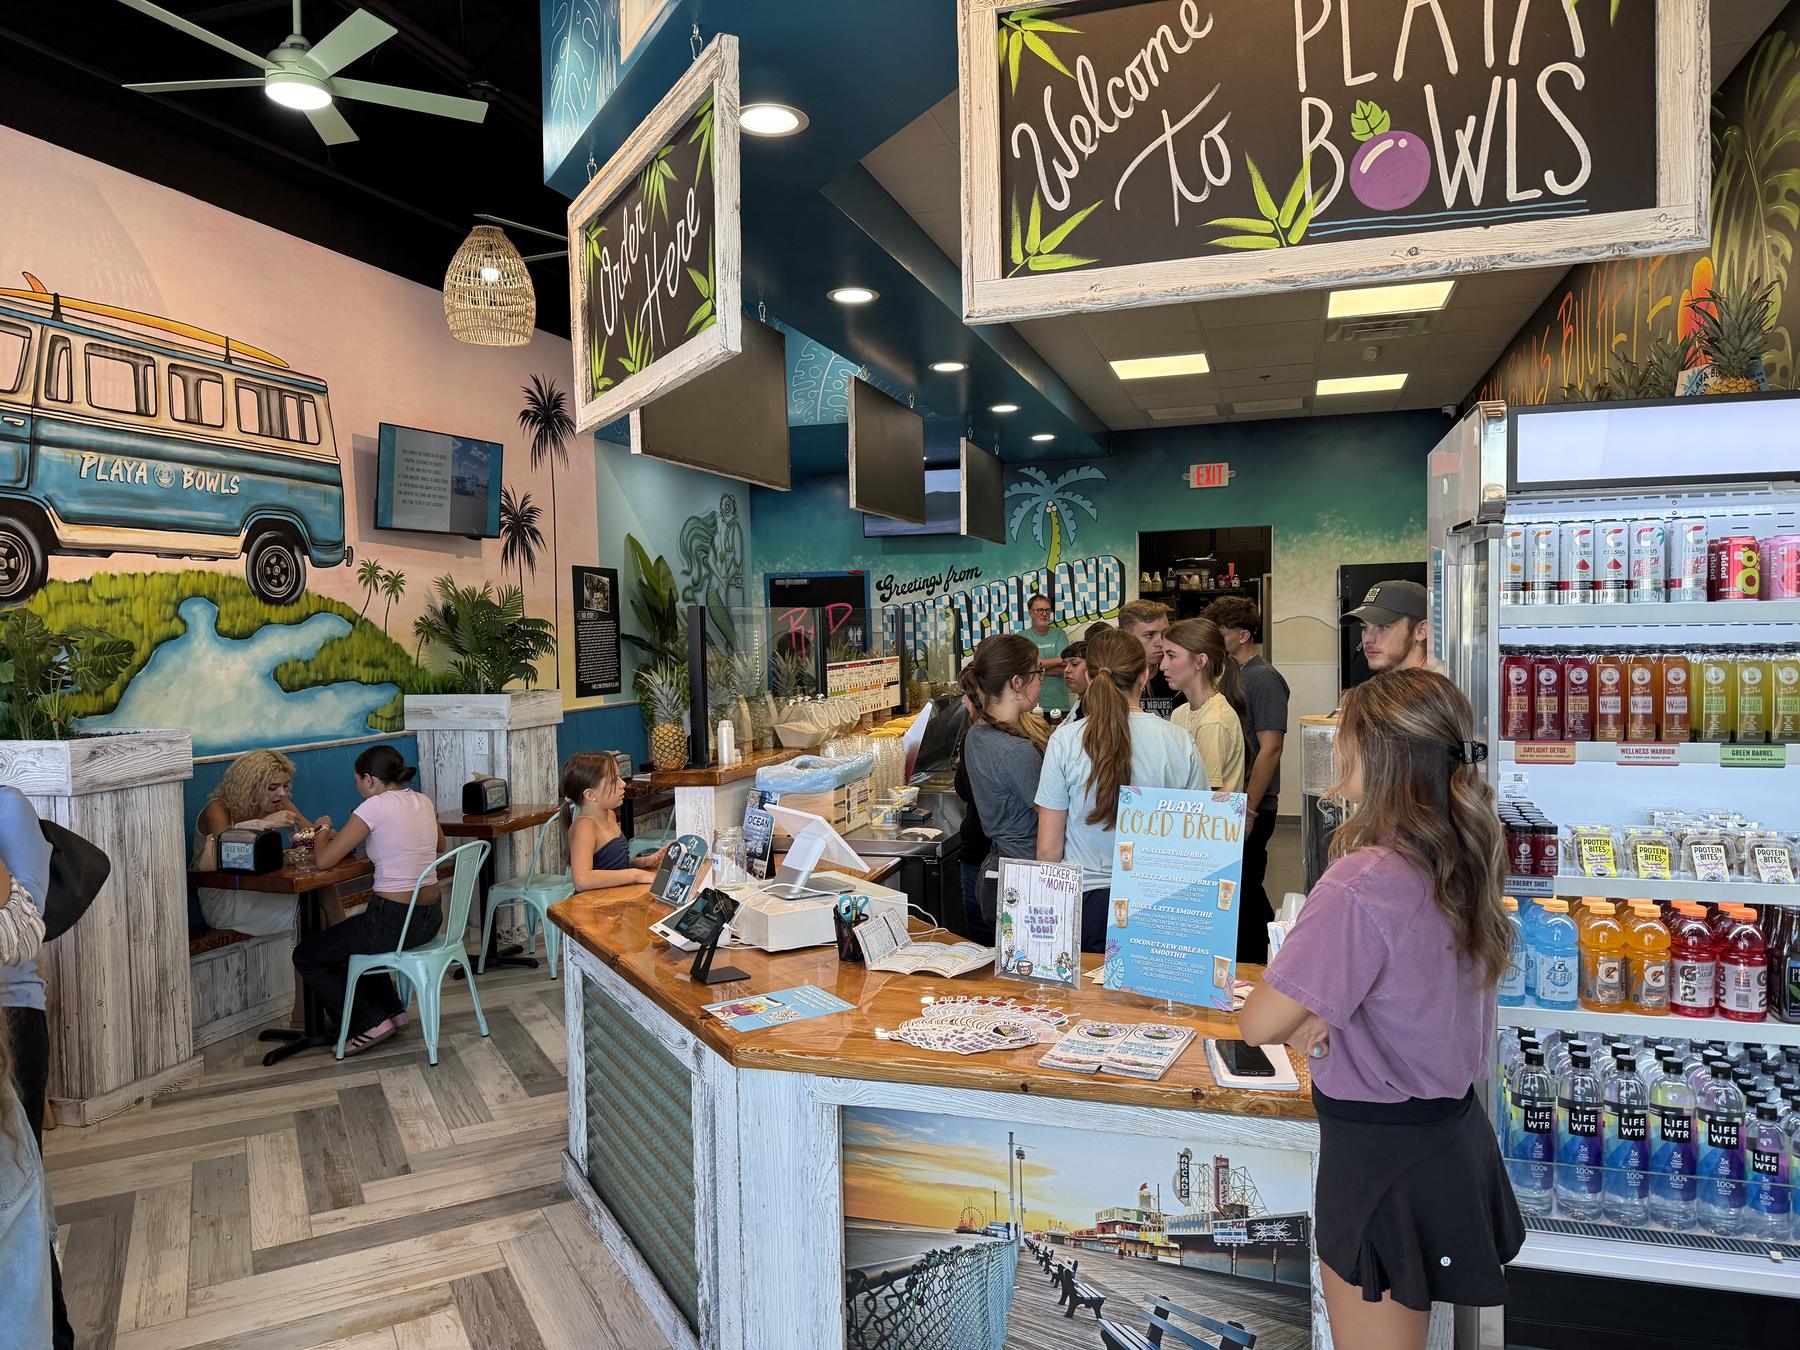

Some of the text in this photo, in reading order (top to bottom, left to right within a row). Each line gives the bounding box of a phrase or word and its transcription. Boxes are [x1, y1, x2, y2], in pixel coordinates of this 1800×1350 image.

[1012, 0, 1214, 212] Welcome
[1115, 83, 1232, 226] to
[601, 201, 647, 337] Order
[640, 187, 700, 347] Here
[80, 451, 240, 495] PLAYA BOWLS
[1196, 464, 1224, 486] EXIT
[1719, 551, 1729, 579] poppi
[876, 564, 982, 603] Greetings from
[1156, 798, 1205, 814] PLAYA
[748, 816, 770, 828] OCEAN
[1118, 807, 1241, 843] COLD BREW
[1639, 847, 1666, 855] PROTEIN
[1693, 846, 1722, 854] PROTEIN
[1040, 864, 1070, 880] STICKER
[1046, 877, 1078, 894] MONTH!
[1175, 907, 1214, 918] SMOOTHIE
[1030, 925, 1053, 934] bowl
[1129, 937, 1210, 955] COCONUT NEW ORLEANS
[1149, 947, 1187, 959] SMOOTHIE
[1545, 970, 1572, 982] ZERO
[1527, 1111, 1550, 1119] LIFE
[1571, 1112, 1595, 1122] LIFE
[1527, 1120, 1550, 1129] WTR
[1571, 1122, 1595, 1132] WTR
[1621, 1117, 1645, 1126] LIFE
[1664, 1118, 1689, 1128] LIFE
[1621, 1127, 1645, 1136] WTR
[1664, 1128, 1689, 1138] WTR
[1711, 1124, 1737, 1134] LIFE
[1711, 1134, 1737, 1145] WTR
[1754, 1152, 1777, 1163] LIFE
[1754, 1162, 1777, 1172] WTR
[1181, 1157, 1189, 1197] ARCADE
